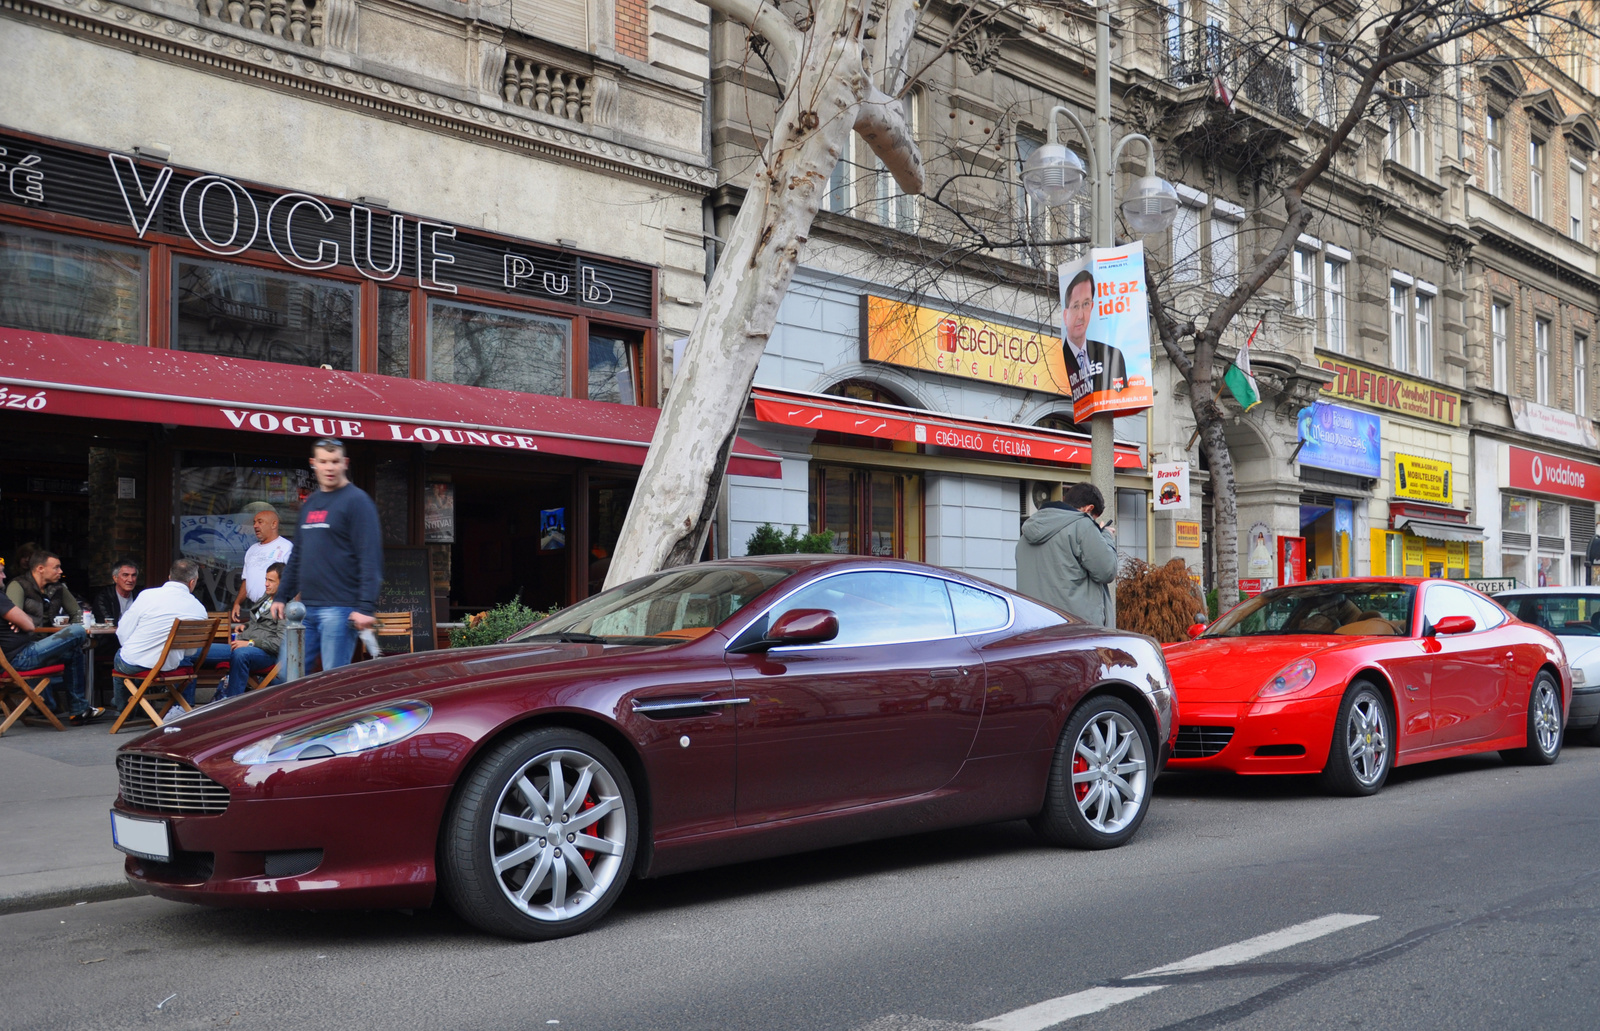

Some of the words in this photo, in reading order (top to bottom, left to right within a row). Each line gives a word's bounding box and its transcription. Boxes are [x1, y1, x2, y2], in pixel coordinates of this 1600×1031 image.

[108, 153, 458, 295] VOGUE
[503, 254, 614, 305] Pub
[1097, 281, 1116, 298] Itt
[1118, 280, 1139, 294] az
[1098, 295, 1131, 317] idő!
[957, 325, 1039, 365] EBÉD-LELŐ
[937, 353, 1038, 386] ÉTELBÁR
[1318, 360, 1402, 409] STAFIÓK
[1429, 390, 1457, 422] ITT
[220, 409, 365, 438] VOGUE
[390, 424, 538, 450] LOUNGE
[935, 430, 983, 450] EBÉD-LELŐ
[992, 437, 1031, 456] ÉTELBÁR
[1408, 471, 1442, 483] MOBILTELEFON
[1544, 465, 1585, 489] vodafone
